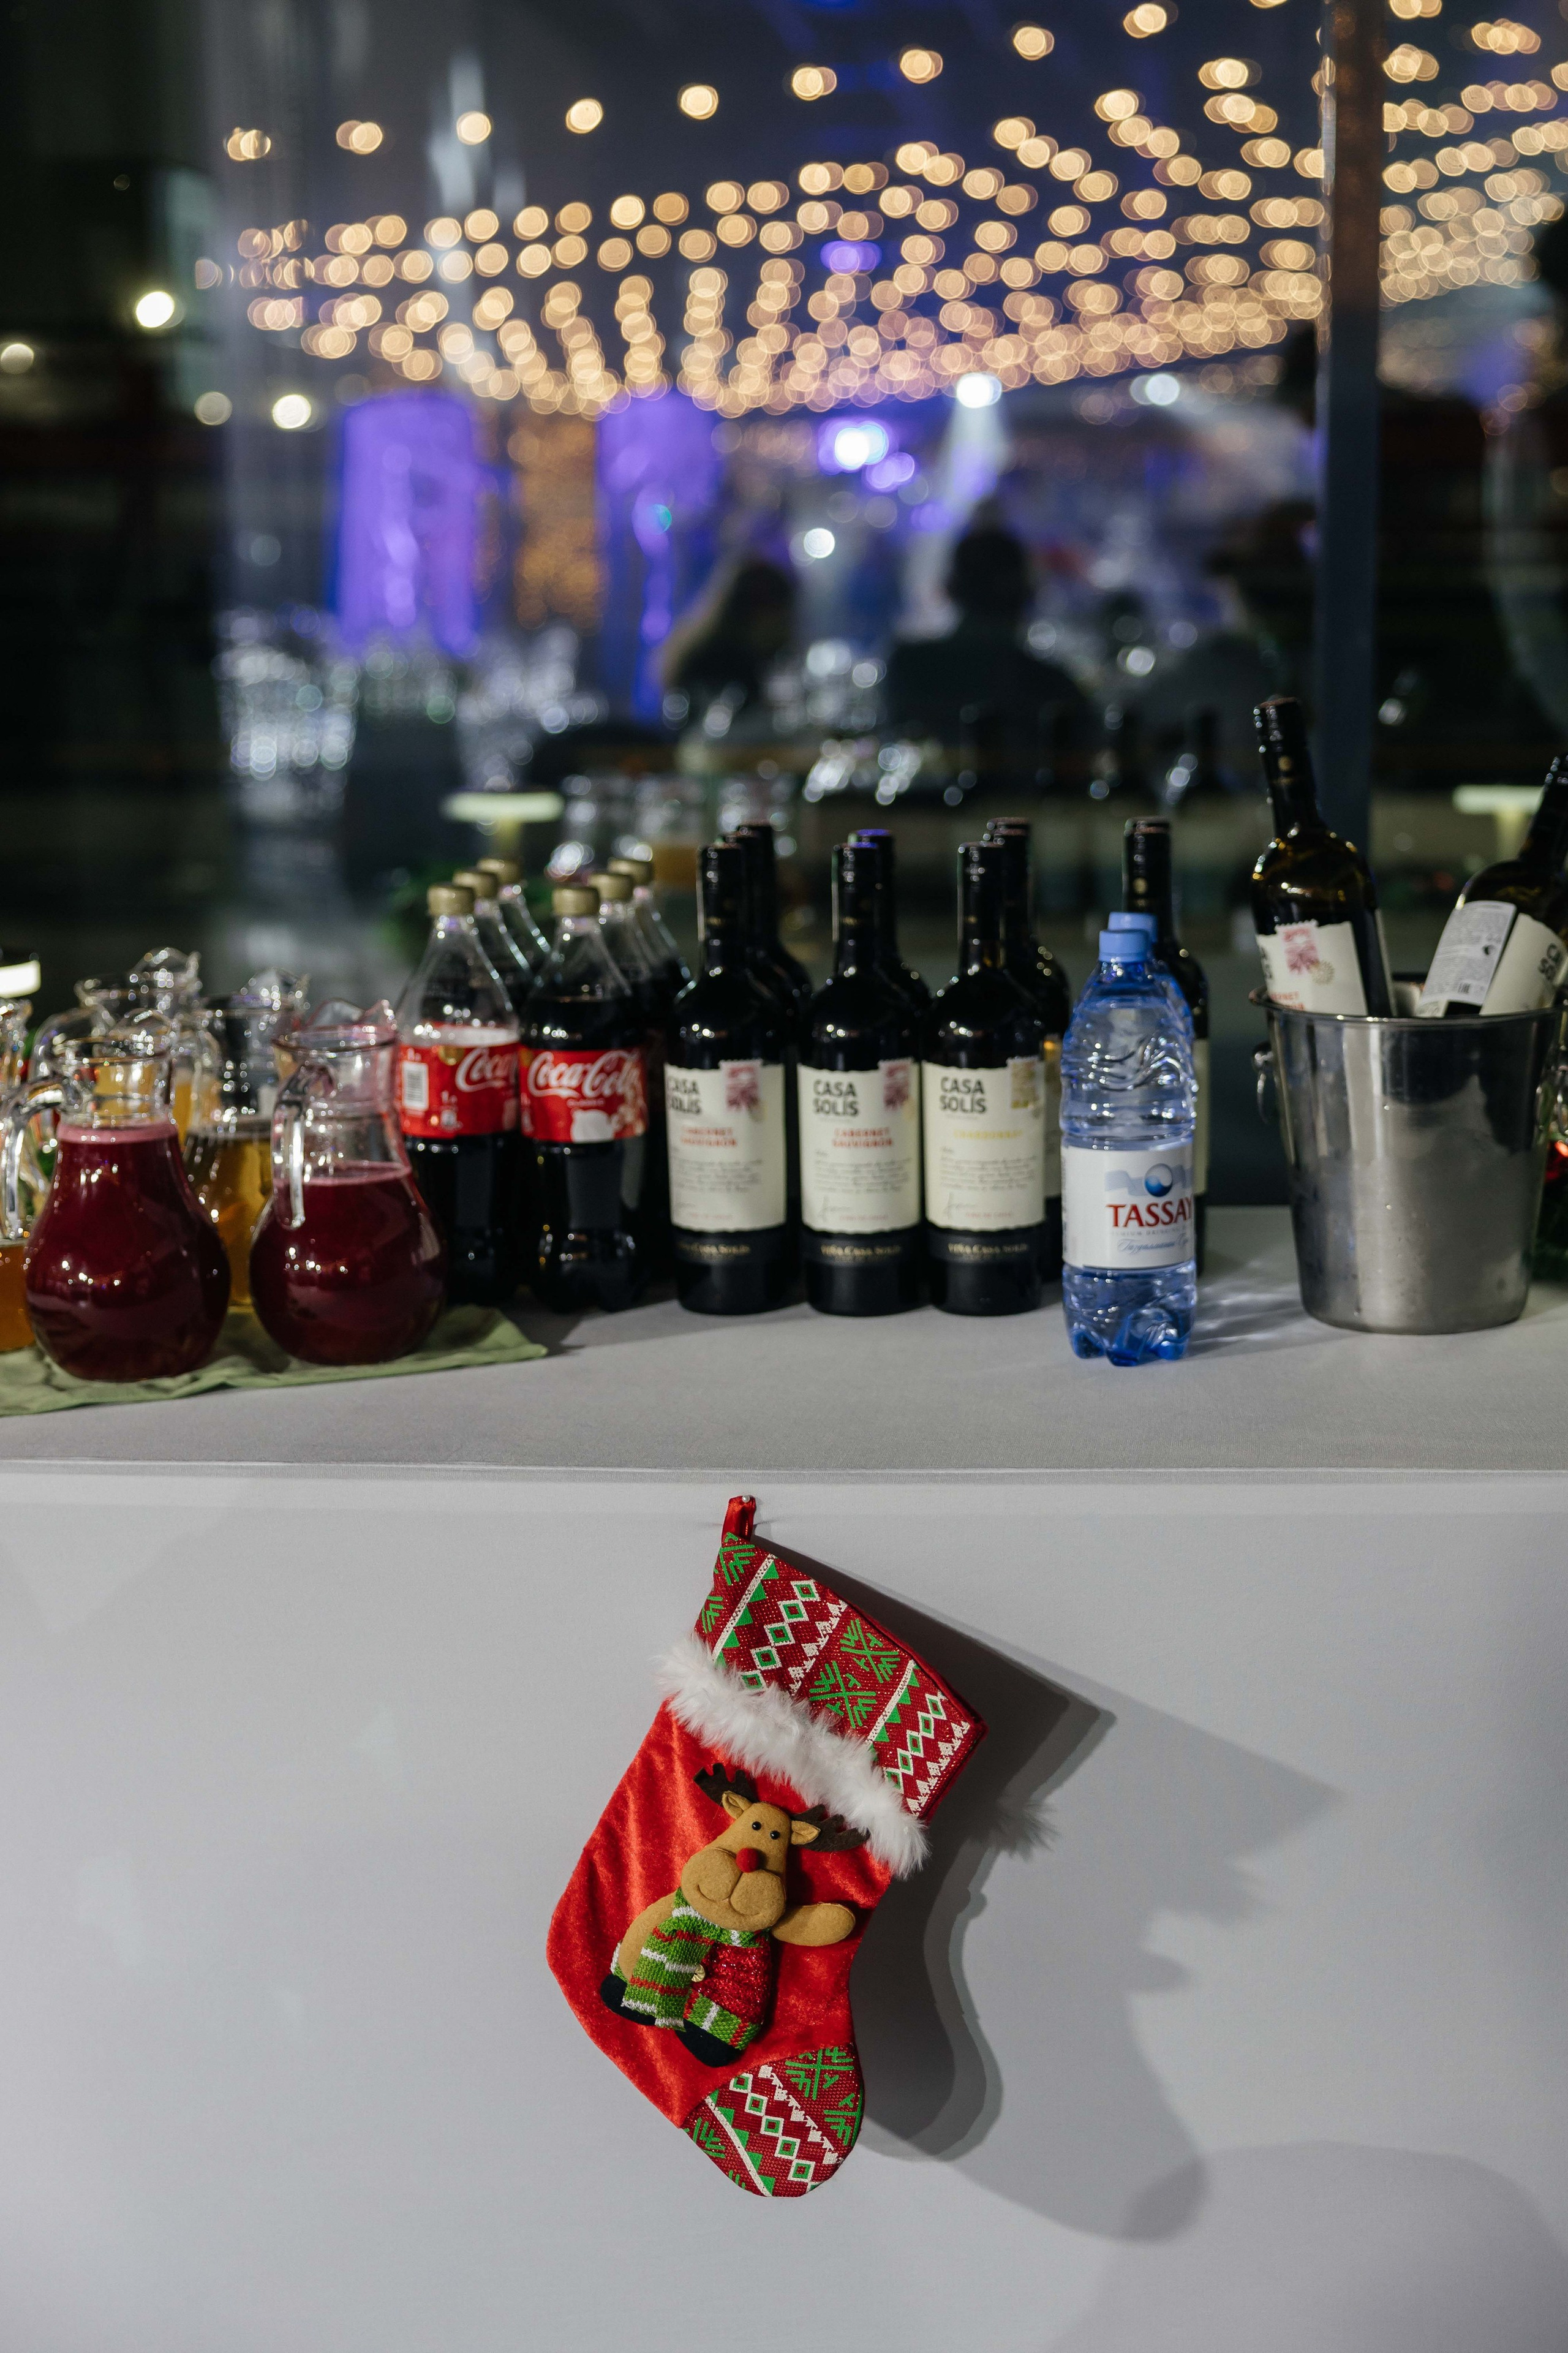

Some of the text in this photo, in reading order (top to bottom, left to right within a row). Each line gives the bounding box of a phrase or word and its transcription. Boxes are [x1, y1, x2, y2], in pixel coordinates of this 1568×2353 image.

[813, 1079, 857, 1097] CASA
[940, 1076, 985, 1095] CASA
[1105, 1196, 1192, 1227] TASSAY
